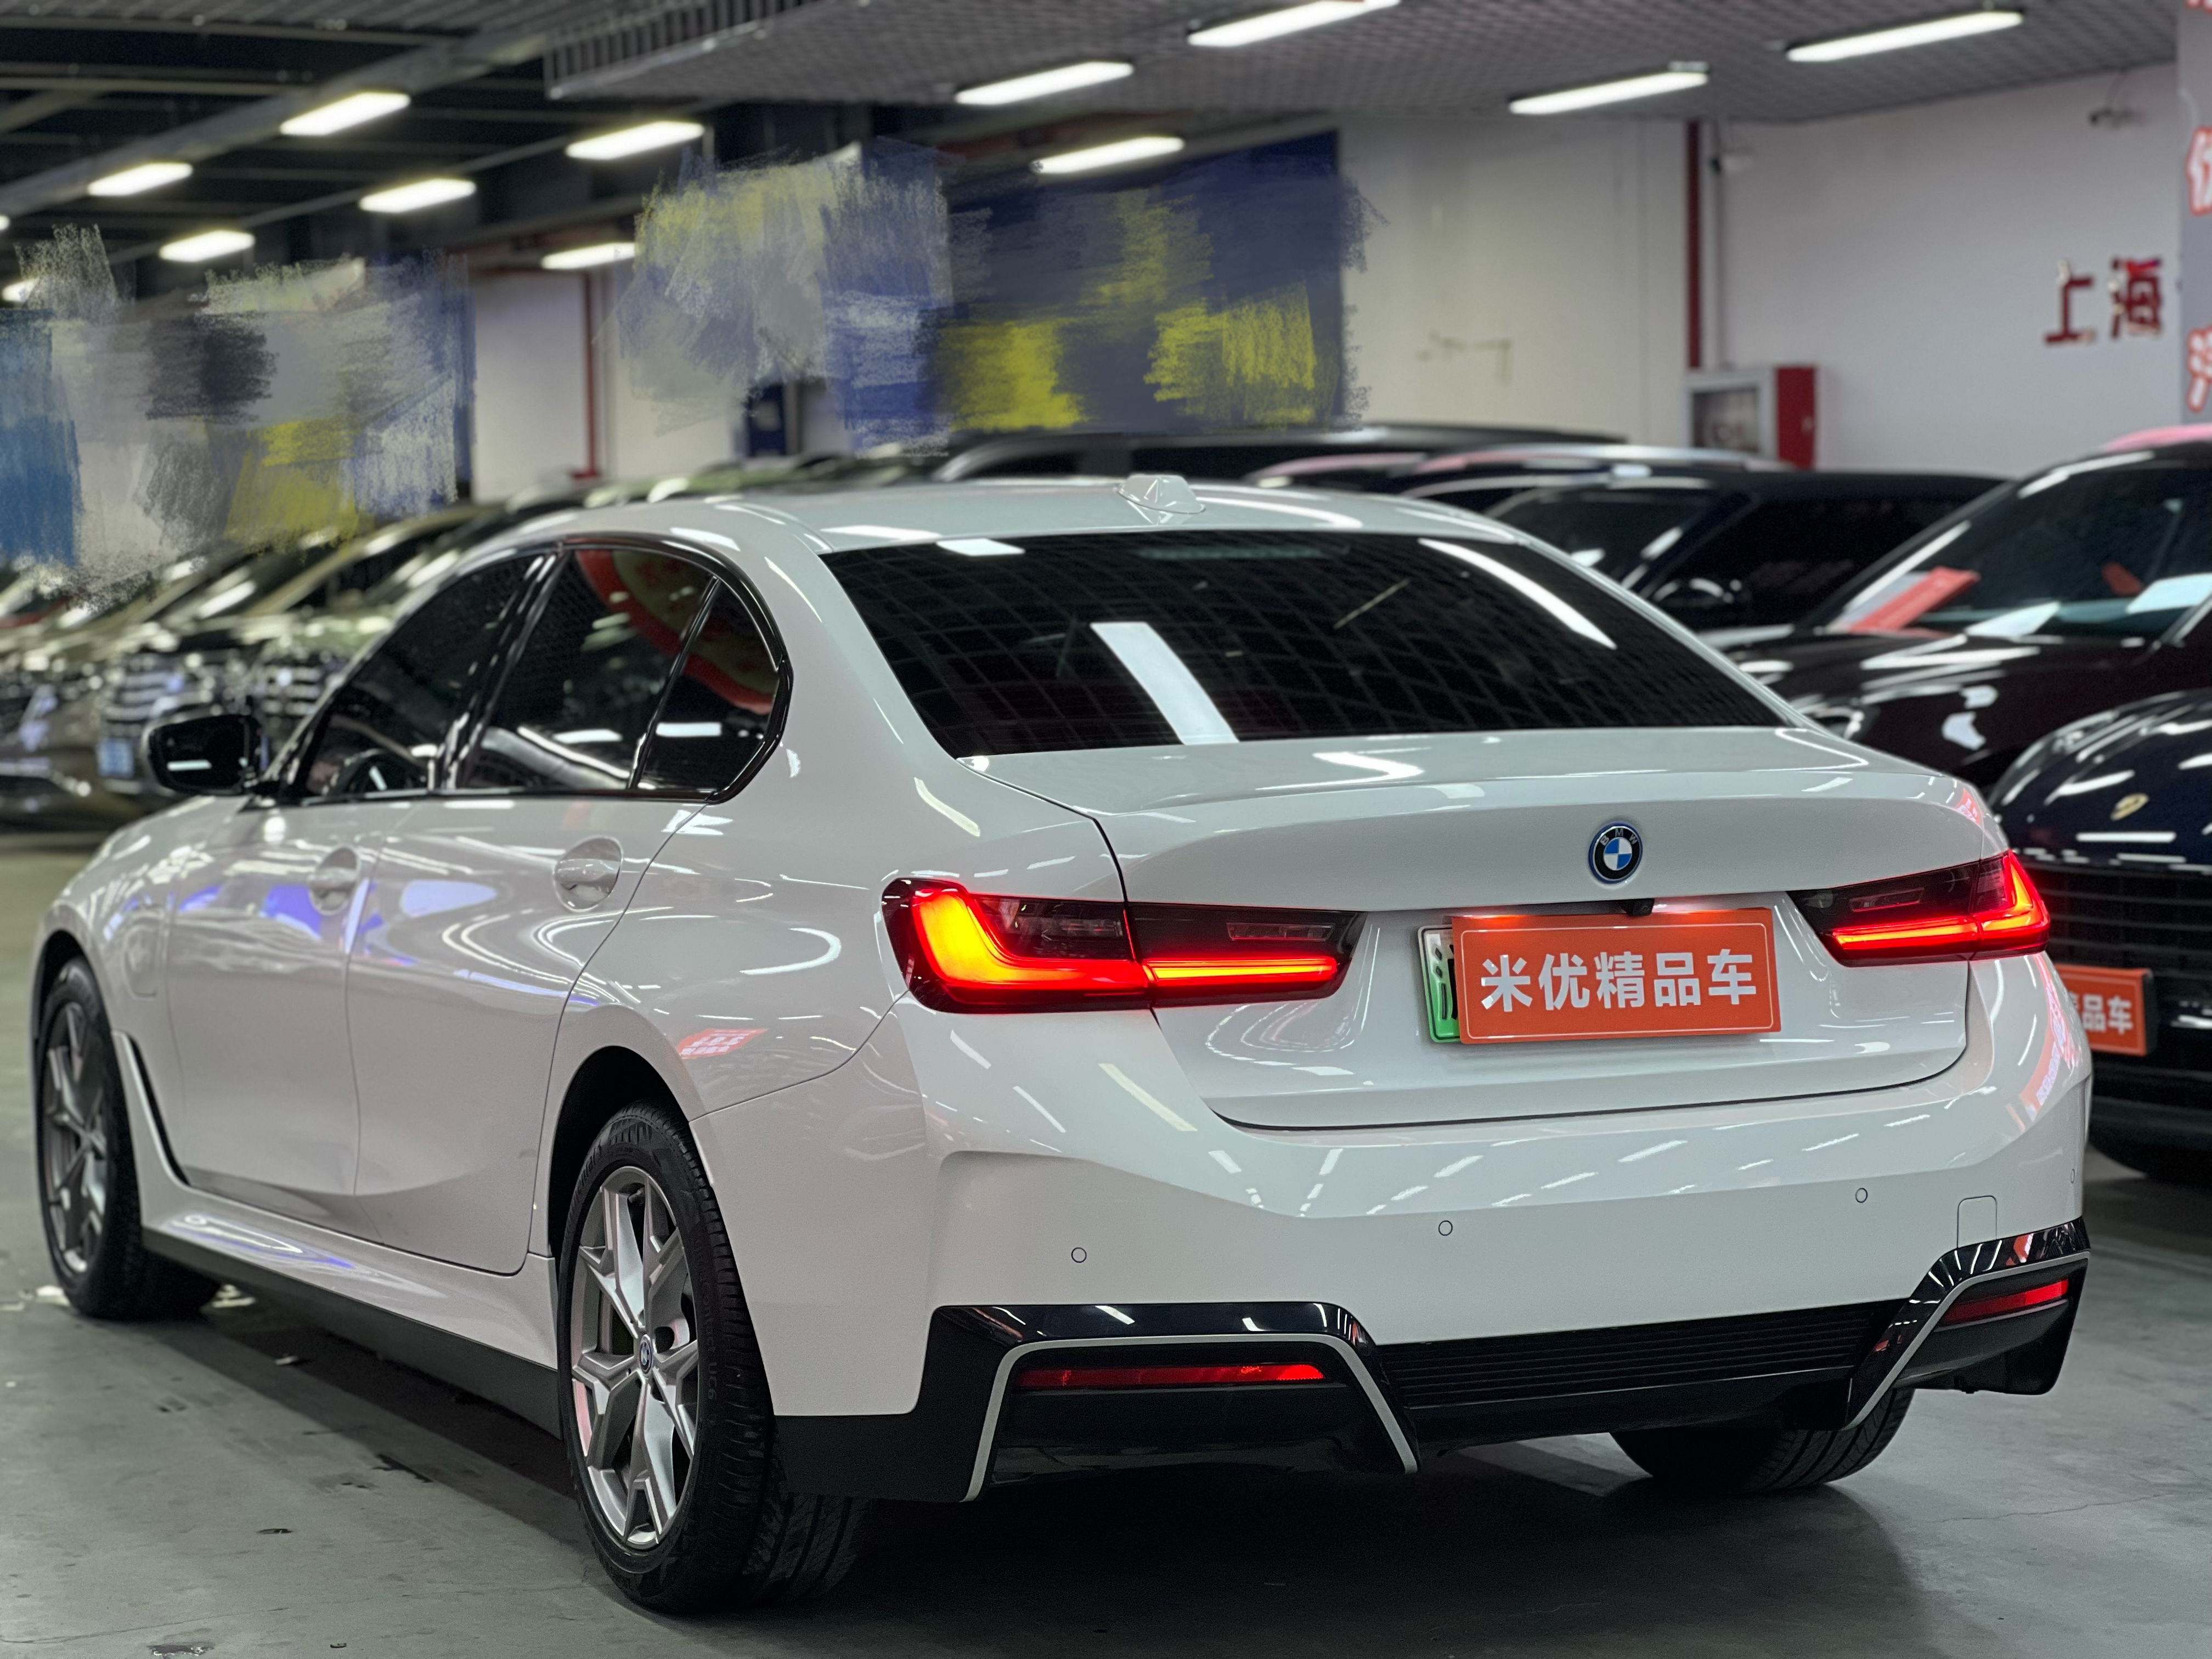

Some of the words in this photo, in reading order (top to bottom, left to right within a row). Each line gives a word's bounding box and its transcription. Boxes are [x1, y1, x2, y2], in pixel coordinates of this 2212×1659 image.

[2044, 257, 2162, 345] 上海
[1600, 828, 1638, 846] BMW
[1480, 948, 1757, 1012] 米优精品车
[2069, 991, 2134, 1035] 品车
[708, 1362, 717, 1400] UC6
